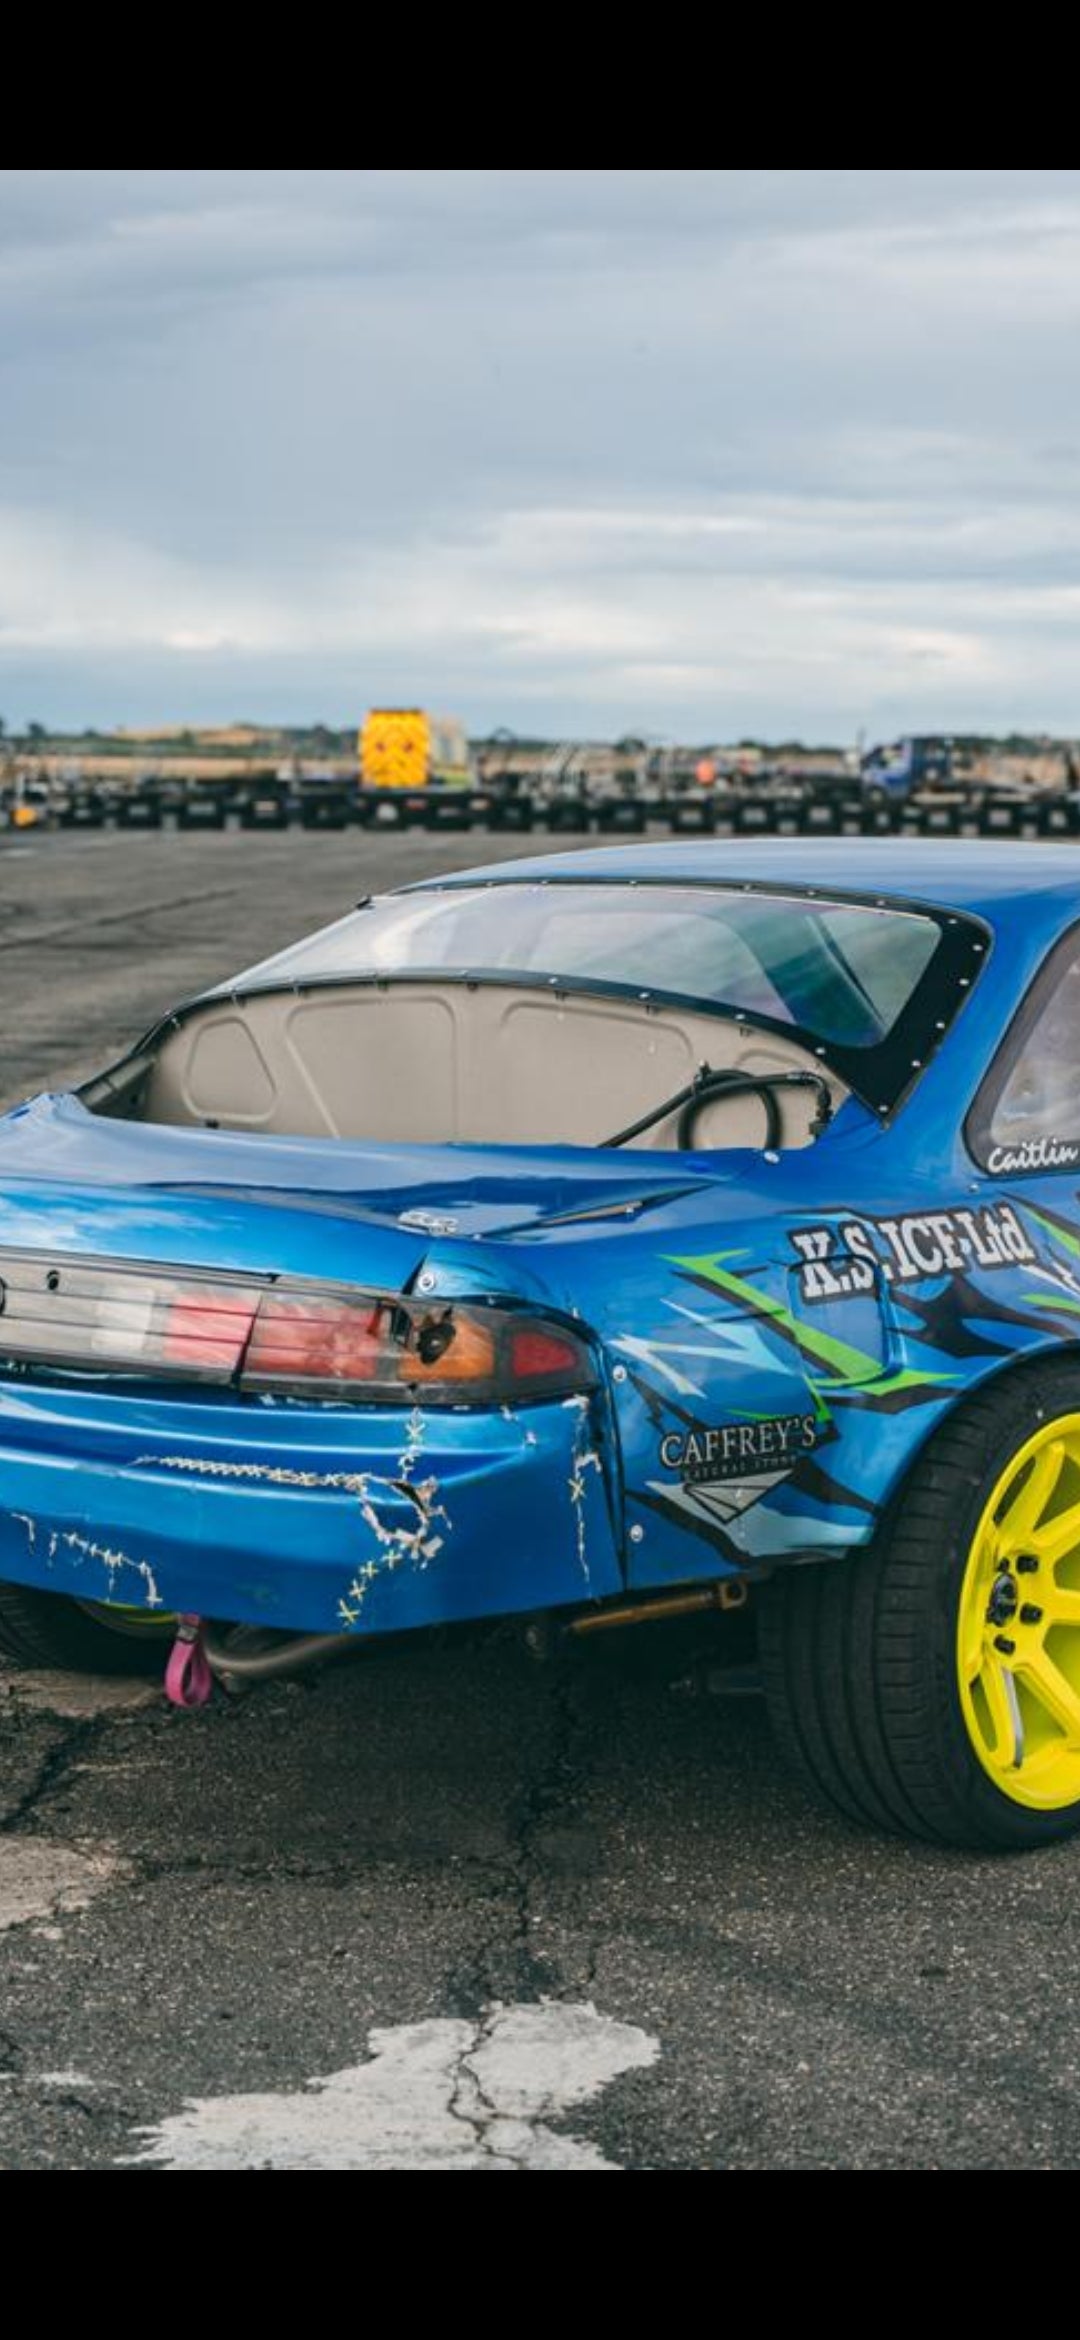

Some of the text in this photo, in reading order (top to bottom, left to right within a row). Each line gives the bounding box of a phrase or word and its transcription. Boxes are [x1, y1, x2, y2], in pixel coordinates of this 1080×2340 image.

[988, 1138, 1079, 1174] Caitlin
[953, 1206, 1036, 1264] Ltd
[660, 1416, 817, 1467] CAFFREY'S
